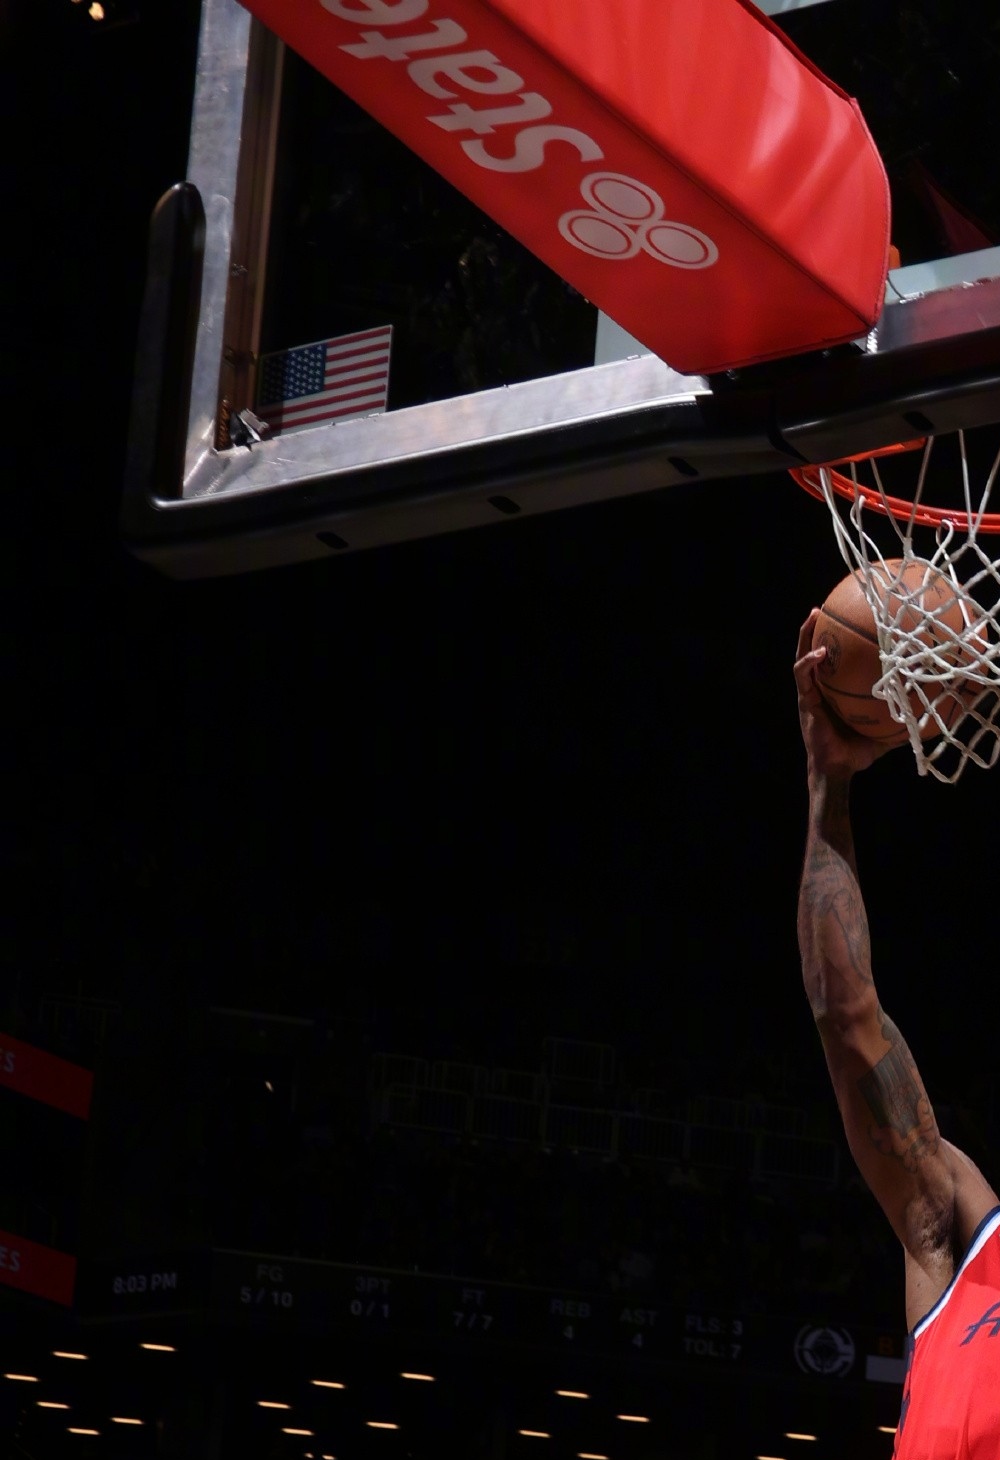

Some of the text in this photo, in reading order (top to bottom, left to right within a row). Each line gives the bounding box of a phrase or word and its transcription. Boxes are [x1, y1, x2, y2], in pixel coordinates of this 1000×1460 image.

[256, 1264, 284, 1282] FG
[112, 1272, 177, 1294] 8:03 PM
[355, 1276, 391, 1294] 3PT
[551, 1299, 591, 1319] REB
[620, 1307, 658, 1326] AST
[563, 1325, 574, 1341] 4
[732, 1319, 743, 1336] 3
[632, 1333, 644, 1348] 4
[730, 1344, 743, 1360] 7
